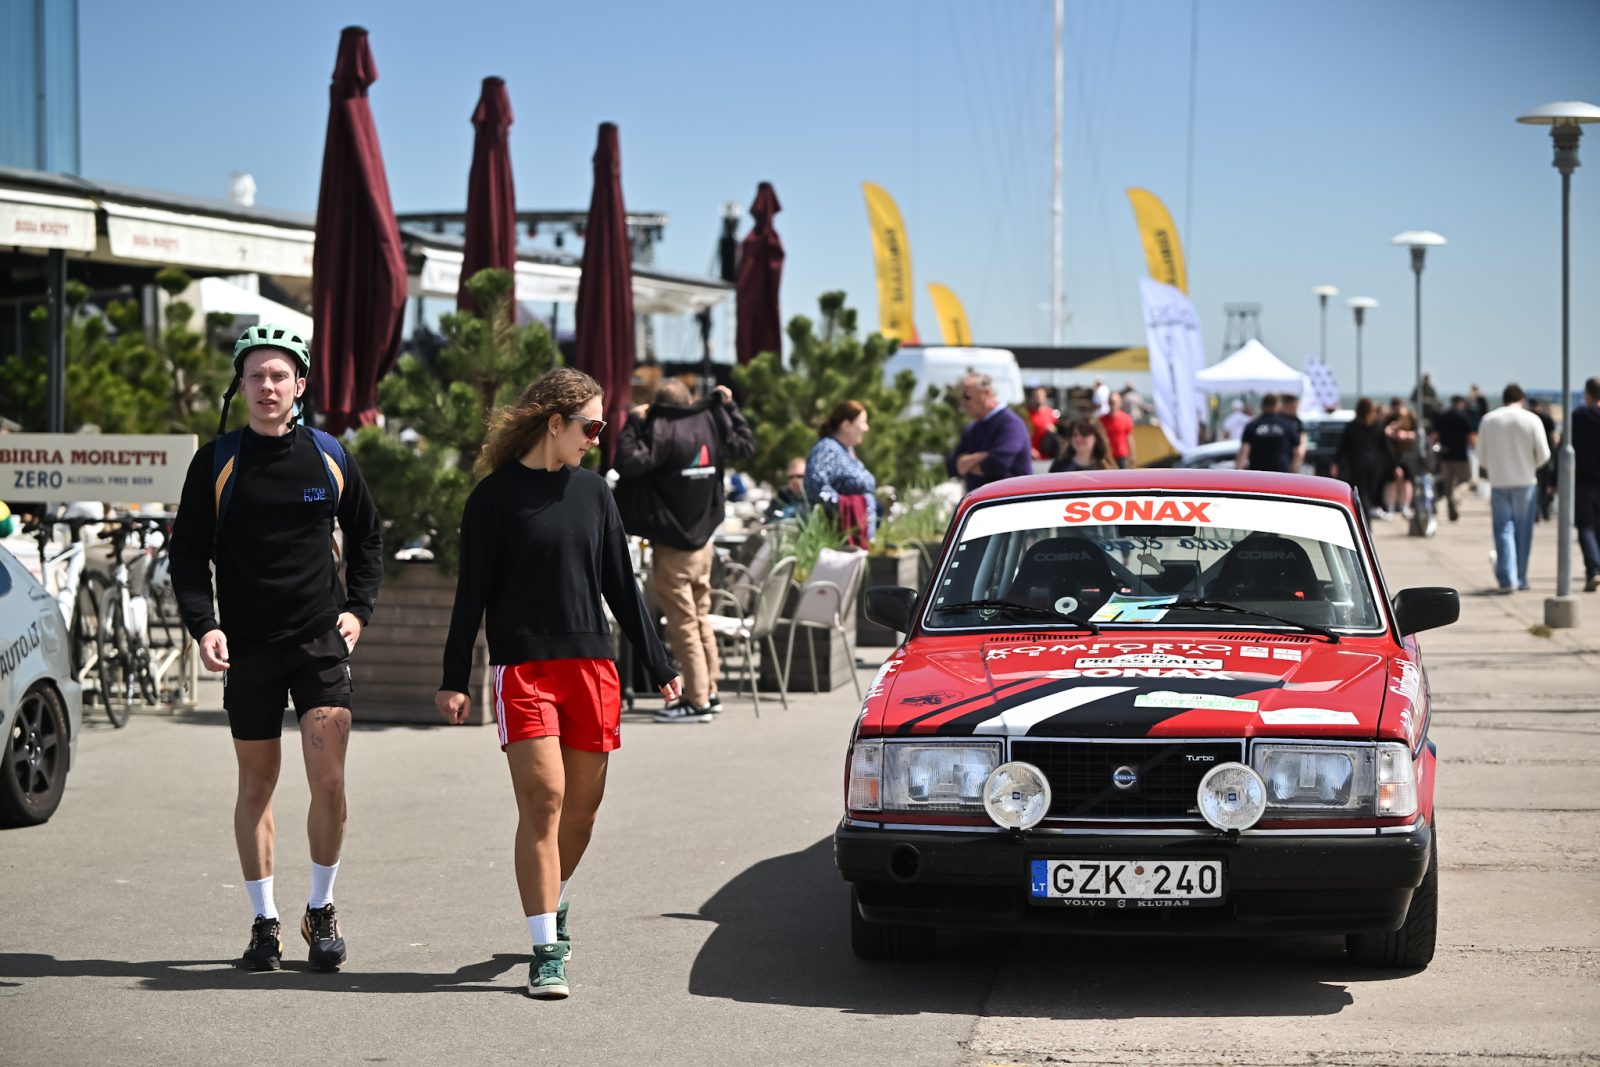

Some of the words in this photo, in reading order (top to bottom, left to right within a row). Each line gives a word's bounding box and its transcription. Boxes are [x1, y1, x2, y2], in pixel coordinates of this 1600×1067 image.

[0, 450, 65, 464] BIRRA
[71, 450, 168, 465] MORETTI
[14, 471, 63, 488] ZERO
[67, 477, 104, 485] ALCOHOL
[109, 477, 129, 485] FREE
[132, 477, 153, 485] BEER
[1063, 500, 1212, 523] SONAX
[1033, 551, 1092, 562] COBRA
[1237, 549, 1296, 560] COBRA
[988, 643, 1233, 656] KOMFORTO
[1151, 658, 1216, 666] RALLY
[1048, 667, 1235, 681] SONAX
[1185, 754, 1215, 762] Turbo
[1053, 864, 1126, 894] GZK
[1153, 865, 1217, 895] 240
[1031, 883, 1046, 892] LT
[1064, 899, 1106, 907] VOLVO
[1137, 899, 1190, 907] KLUBAS
